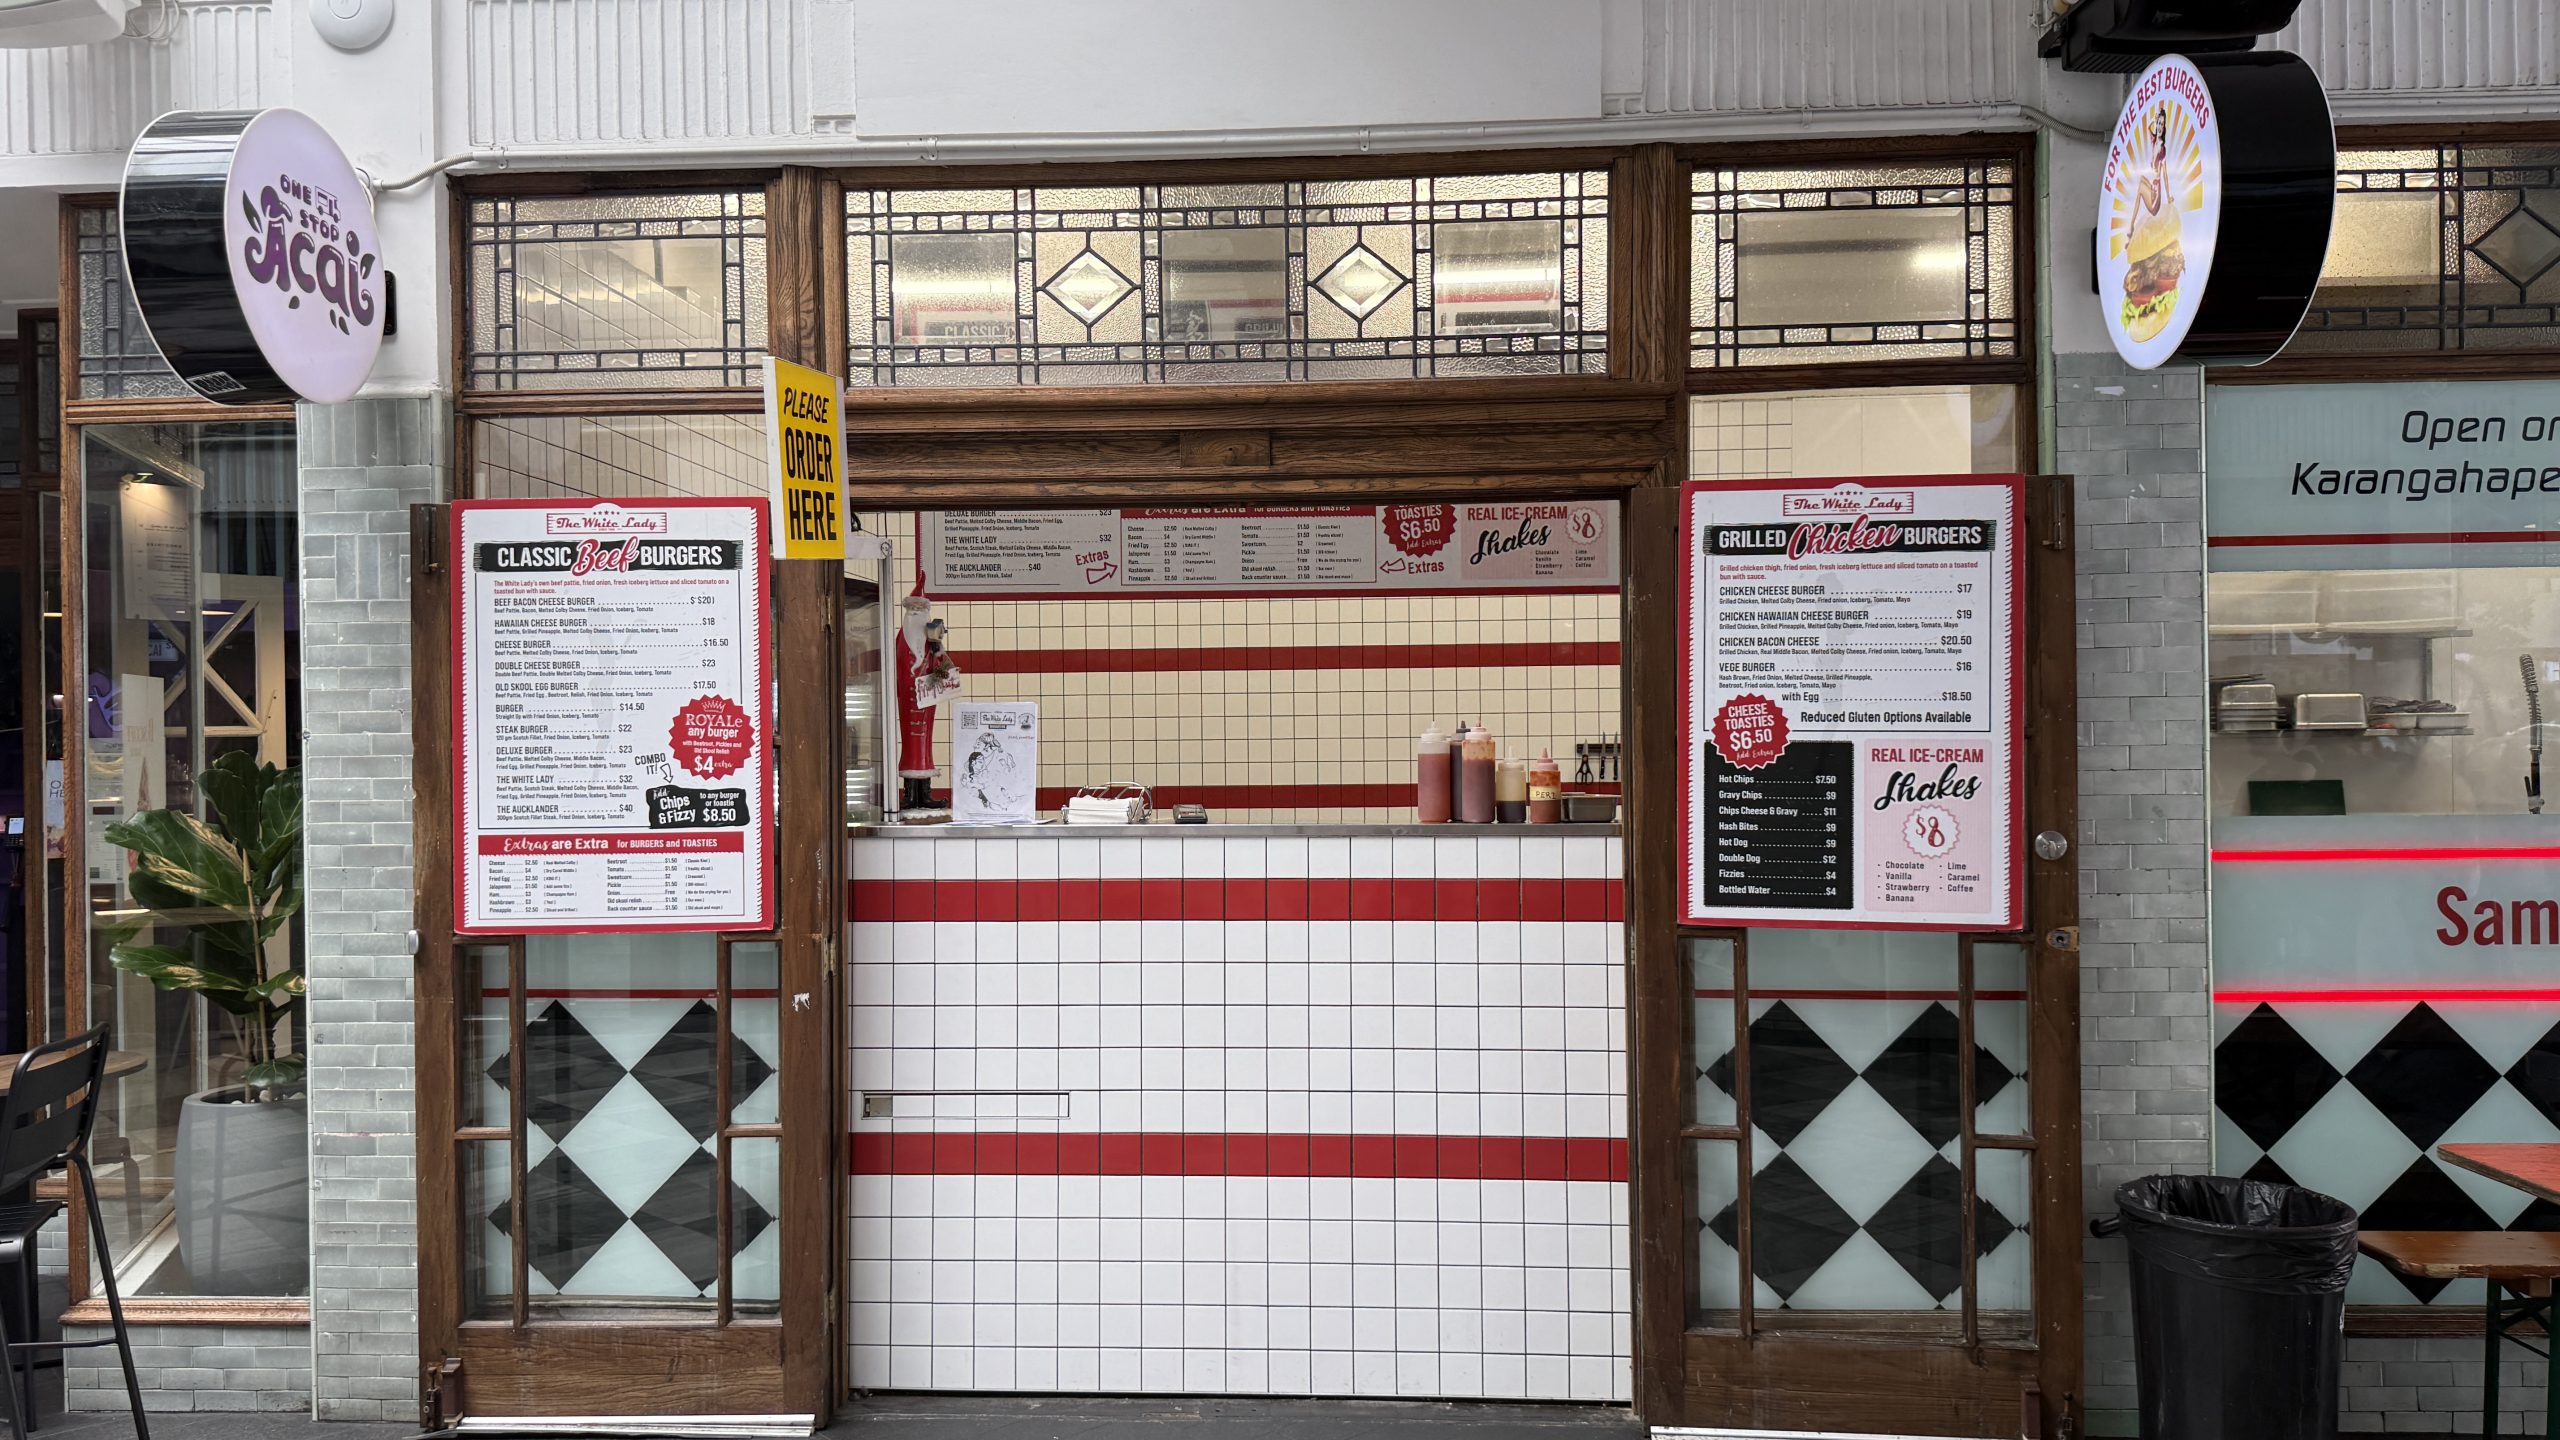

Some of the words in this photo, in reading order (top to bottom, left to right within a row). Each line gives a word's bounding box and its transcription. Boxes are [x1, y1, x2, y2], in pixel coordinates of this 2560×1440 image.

[2104, 148, 2121, 193] FOR
[2117, 105, 2137, 142] THE
[2136, 69, 2163, 110] BEST
[2164, 66, 2210, 129] BURGERS
[280, 174, 312, 205] ONE
[300, 211, 340, 243] STOP
[784, 387, 829, 423] PLEASE
[2401, 410, 2506, 450] Open
[785, 427, 833, 483] ORDER
[2291, 461, 2560, 501] Karangahape
[1793, 498, 1820, 510] The
[1821, 498, 1863, 509] White
[1866, 498, 1903, 511] Lady
[788, 488, 837, 540] HERE
[1394, 506, 1443, 521] TOASTIES
[1467, 507, 1498, 521] REAL
[1502, 506, 1567, 521] ICE-CREAM
[556, 517, 579, 529] The
[580, 517, 619, 528] White
[623, 517, 657, 530] Lady
[1399, 519, 1441, 540] $6.50
[1572, 512, 1595, 539] $8
[945, 536, 958, 544] THE
[958, 536, 979, 544] WHITE
[980, 535, 997, 544] LADY
[1099, 533, 1112, 543] $32
[1470, 518, 1552, 565] Shakes
[1719, 529, 1786, 549] GRILLED
[1787, 514, 1902, 560] Chicken
[1904, 526, 1982, 545] BURGERS
[497, 546, 572, 568] CLASSIC
[572, 536, 639, 576] Beef
[640, 546, 722, 566] BURGERS
[1075, 550, 1109, 566] Extras
[1408, 560, 1445, 575] Extras
[1719, 586, 1756, 596] CHICKEN
[1757, 585, 1790, 596] CHEESE
[1791, 585, 1825, 595] BURGER
[1957, 583, 1973, 594] $17
[494, 597, 512, 607] BEEF
[513, 597, 537, 607] BACON
[538, 597, 566, 606] CHEESE
[567, 597, 595, 606] BURGER
[1719, 611, 1756, 622] CHICKEN
[1757, 611, 1799, 621] HAWAIIAN
[1800, 610, 1833, 621] CHEESE
[1834, 610, 1869, 621] BURGER
[1956, 609, 1972, 620] $19
[494, 619, 529, 628] HAWAIIAN
[530, 618, 558, 627] CHEESE
[559, 618, 588, 627] BURGER
[494, 640, 522, 649] CHEESE
[523, 640, 551, 649] BURGER
[703, 638, 729, 647] $16.50
[1719, 637, 1755, 647] CHICKEN
[1757, 636, 1786, 647] BACON
[1787, 636, 1820, 647] CHEESE
[1941, 635, 1972, 646] $20.50
[495, 661, 523, 670] DOUBLE
[523, 661, 551, 670] CHEESE
[552, 660, 581, 670] BURGER
[702, 659, 716, 668] $23
[1719, 662, 1740, 672] VEGE
[1742, 662, 1775, 672] BURGER
[1956, 661, 1972, 672] $16
[495, 683, 509, 692] OLD
[510, 682, 534, 691] SKOOL
[535, 682, 549, 691] EGG
[550, 682, 579, 691] BURGER
[693, 680, 717, 690] $17.50
[1781, 692, 1801, 701] with
[1803, 691, 1819, 703] Egg
[1942, 691, 1972, 702] $18.50
[495, 704, 524, 713] BURGER
[619, 702, 645, 712] $14.50
[1728, 703, 1768, 718] CHEESE
[1724, 715, 1775, 731] TOASTIES
[1801, 711, 1846, 723] Reduced
[1848, 711, 1881, 723] Gluten
[1883, 711, 1923, 725] Options
[1924, 711, 1972, 723] Available
[495, 725, 519, 734] STEAK
[520, 725, 549, 734] BURGER
[618, 724, 632, 733] $22
[687, 726, 706, 739] any
[707, 726, 739, 740] burger
[1730, 729, 1773, 751] $6.50
[496, 746, 523, 755] DELUXE
[524, 746, 553, 755] BURGER
[618, 745, 633, 754] $23
[1872, 748, 1906, 762] REAL
[1910, 749, 1983, 763] ICE-CREAM
[634, 752, 666, 766] COMBO
[694, 757, 714, 772] $4
[646, 762, 658, 775] IT!
[496, 775, 510, 784] THE
[511, 775, 534, 784] WHITE
[535, 775, 554, 784] LADY
[619, 774, 633, 784] $32
[1719, 774, 1733, 783] Hot
[1733, 774, 1755, 785] Chips
[1873, 762, 1982, 810] Shakes
[1535, 790, 1557, 800] PERI
[1718, 790, 1741, 801] Gravy
[1741, 790, 1763, 801] Chips
[1825, 791, 1836, 800] $9
[497, 805, 511, 814] THE
[512, 804, 559, 814] AUCKLANDER
[619, 803, 633, 813] $40
[659, 796, 690, 811] Chips
[702, 809, 736, 822] $8.50
[1718, 806, 1740, 816] Chips
[1740, 806, 1768, 815] Cheese
[1769, 806, 1775, 815] &
[1776, 806, 1798, 817] Gravy
[1823, 807, 1836, 816] $11
[1718, 821, 1738, 831] Hash
[1738, 822, 1759, 831] Bites
[1825, 823, 1836, 832] $9
[1915, 814, 1945, 848] $8
[503, 836, 551, 852] Extras
[551, 840, 572, 849] are
[574, 837, 609, 849] Extra
[616, 839, 628, 848] for
[629, 839, 664, 849] BURGERS
[665, 839, 680, 848] and
[681, 838, 718, 848] TOASTIES
[1719, 837, 1732, 846] Hot
[1733, 837, 1748, 848] Dog
[1825, 839, 1836, 848] $9
[1718, 853, 1745, 862] Double
[1745, 853, 1761, 864] Dog
[1822, 855, 1837, 864] $12
[1885, 860, 1925, 870] Chocolate
[1947, 862, 1967, 870] Lime
[1719, 869, 1745, 878] Fizzies
[1825, 871, 1836, 880] $4
[1885, 872, 1912, 880] Vanilla
[1947, 873, 1980, 882] Caramel
[1719, 884, 1747, 894] Bottled
[1747, 885, 1771, 894] Water
[1825, 887, 1837, 896] $4
[1885, 882, 1930, 893] Strawberry
[1947, 884, 1974, 893] Coffee
[1885, 893, 1914, 902] Banana
[2436, 885, 2560, 946] Sam
